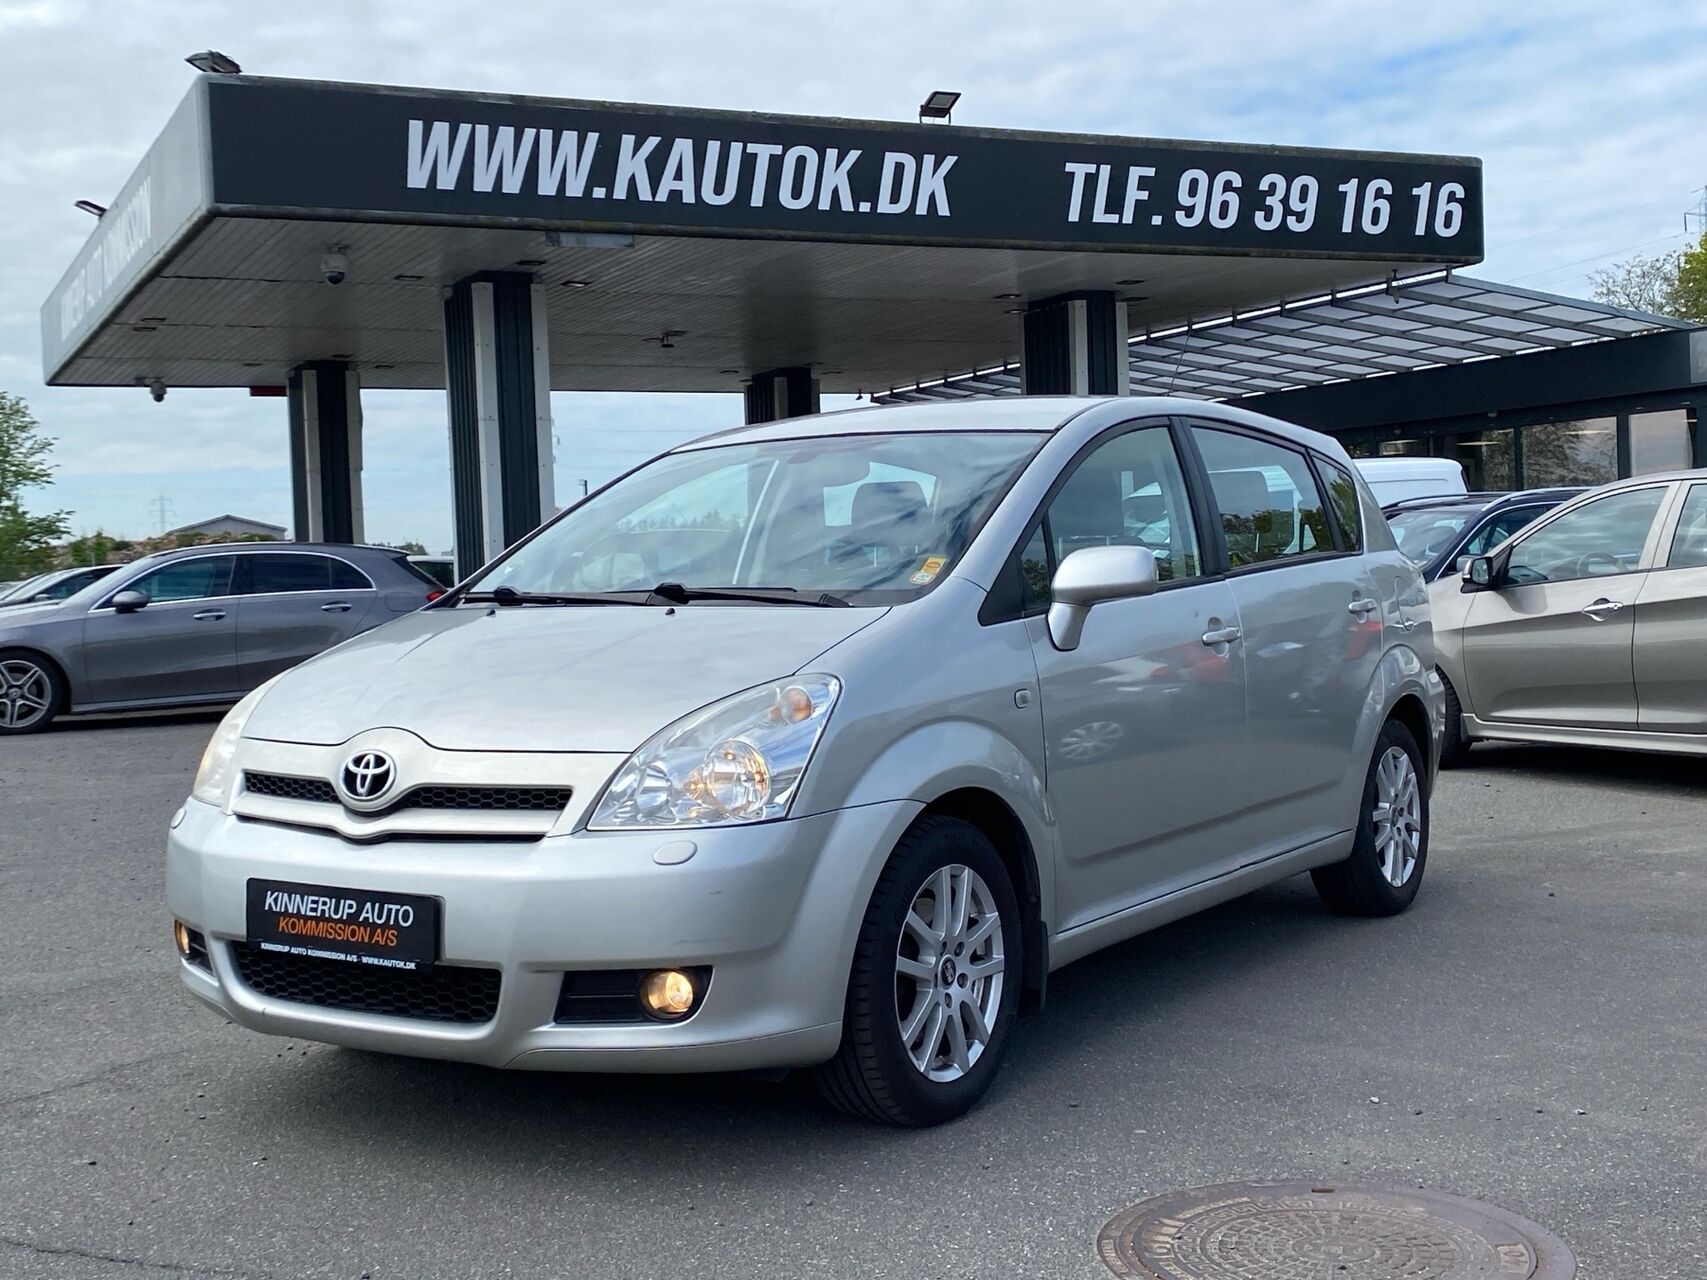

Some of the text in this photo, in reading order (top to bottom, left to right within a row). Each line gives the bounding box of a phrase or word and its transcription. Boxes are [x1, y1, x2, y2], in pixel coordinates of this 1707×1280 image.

[406, 119, 958, 217] WWW.KAUTOK.DK
[1064, 162, 1465, 238] TLF. 96 39 16 16
[264, 891, 414, 927] KINNERUP AUTO
[279, 916, 398, 947] KOMMISSION A/S
